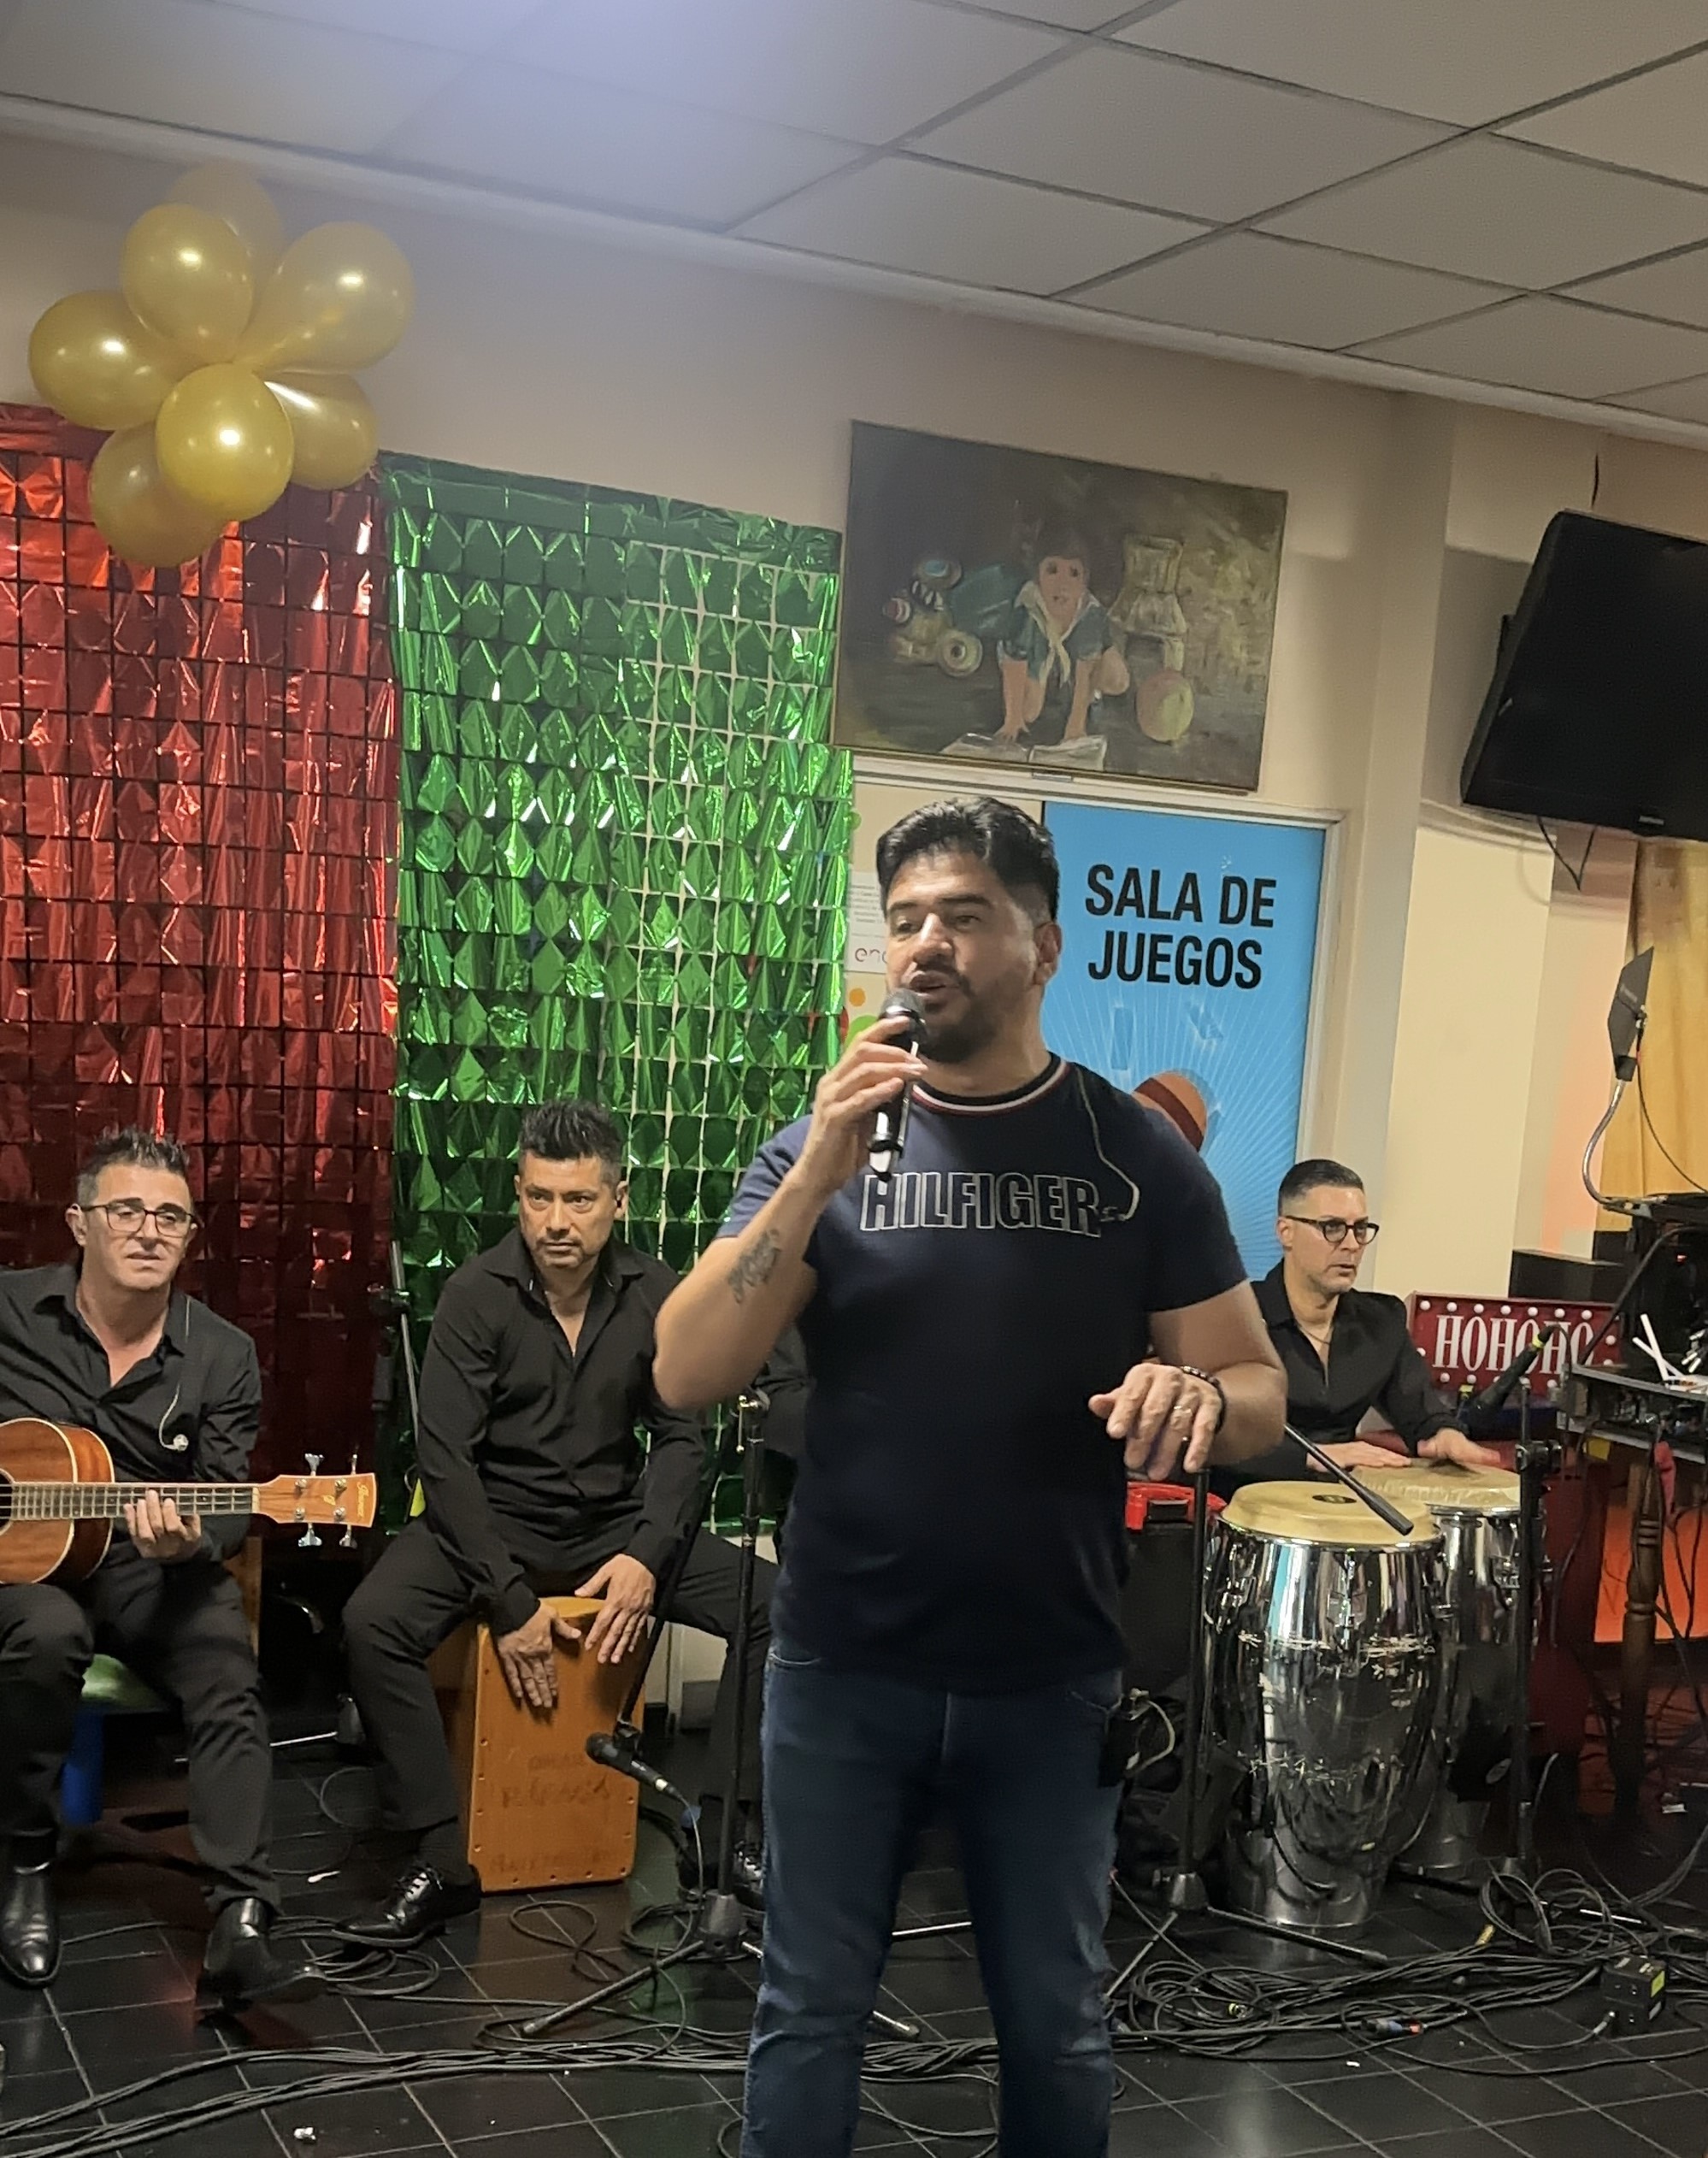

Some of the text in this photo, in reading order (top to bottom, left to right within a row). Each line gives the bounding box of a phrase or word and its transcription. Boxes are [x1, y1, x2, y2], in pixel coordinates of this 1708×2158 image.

[1085, 864, 1277, 928] SALA DE
[1087, 930, 1263, 989] JUEGOS
[860, 1172, 1101, 1237] HILFIGER
